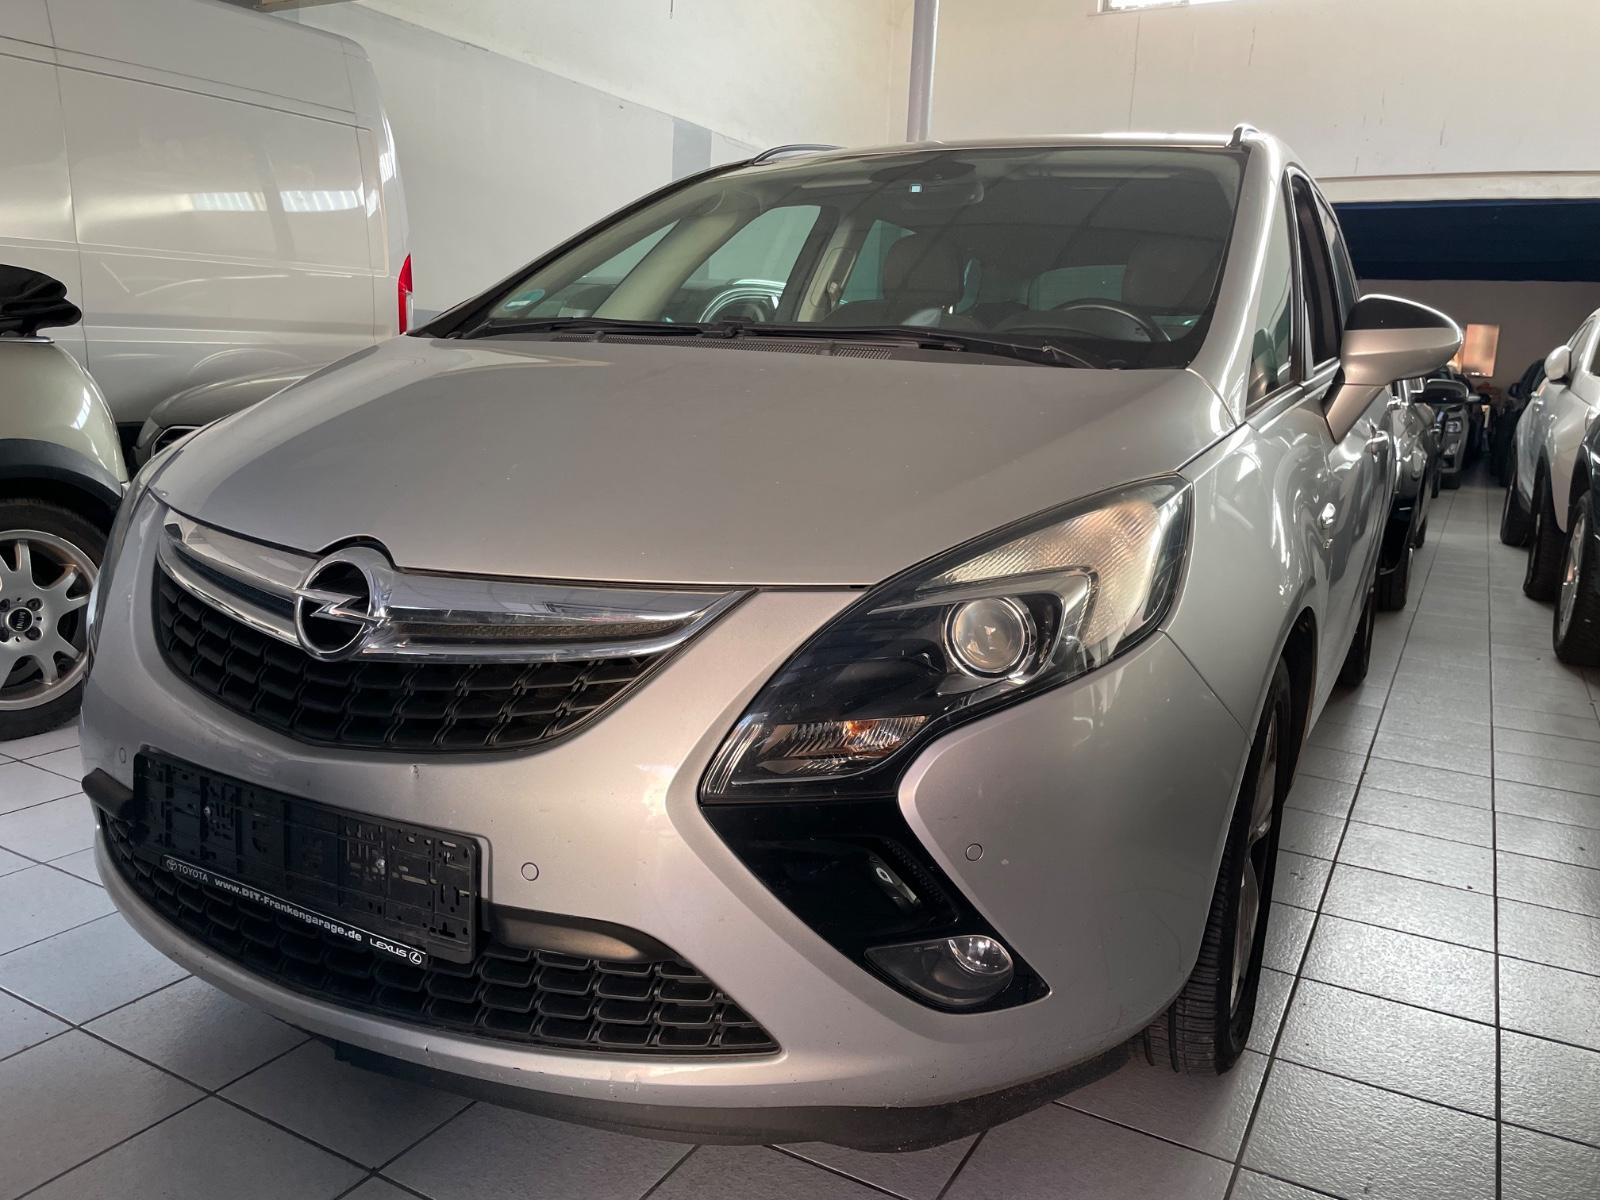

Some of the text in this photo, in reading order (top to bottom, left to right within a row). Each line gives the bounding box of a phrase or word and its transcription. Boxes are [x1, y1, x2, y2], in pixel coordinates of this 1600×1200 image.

[16, 611, 26, 629] MINI
[178, 863, 407, 958] TOYOTA www.DIT-Frankengarage.de LEXUS
